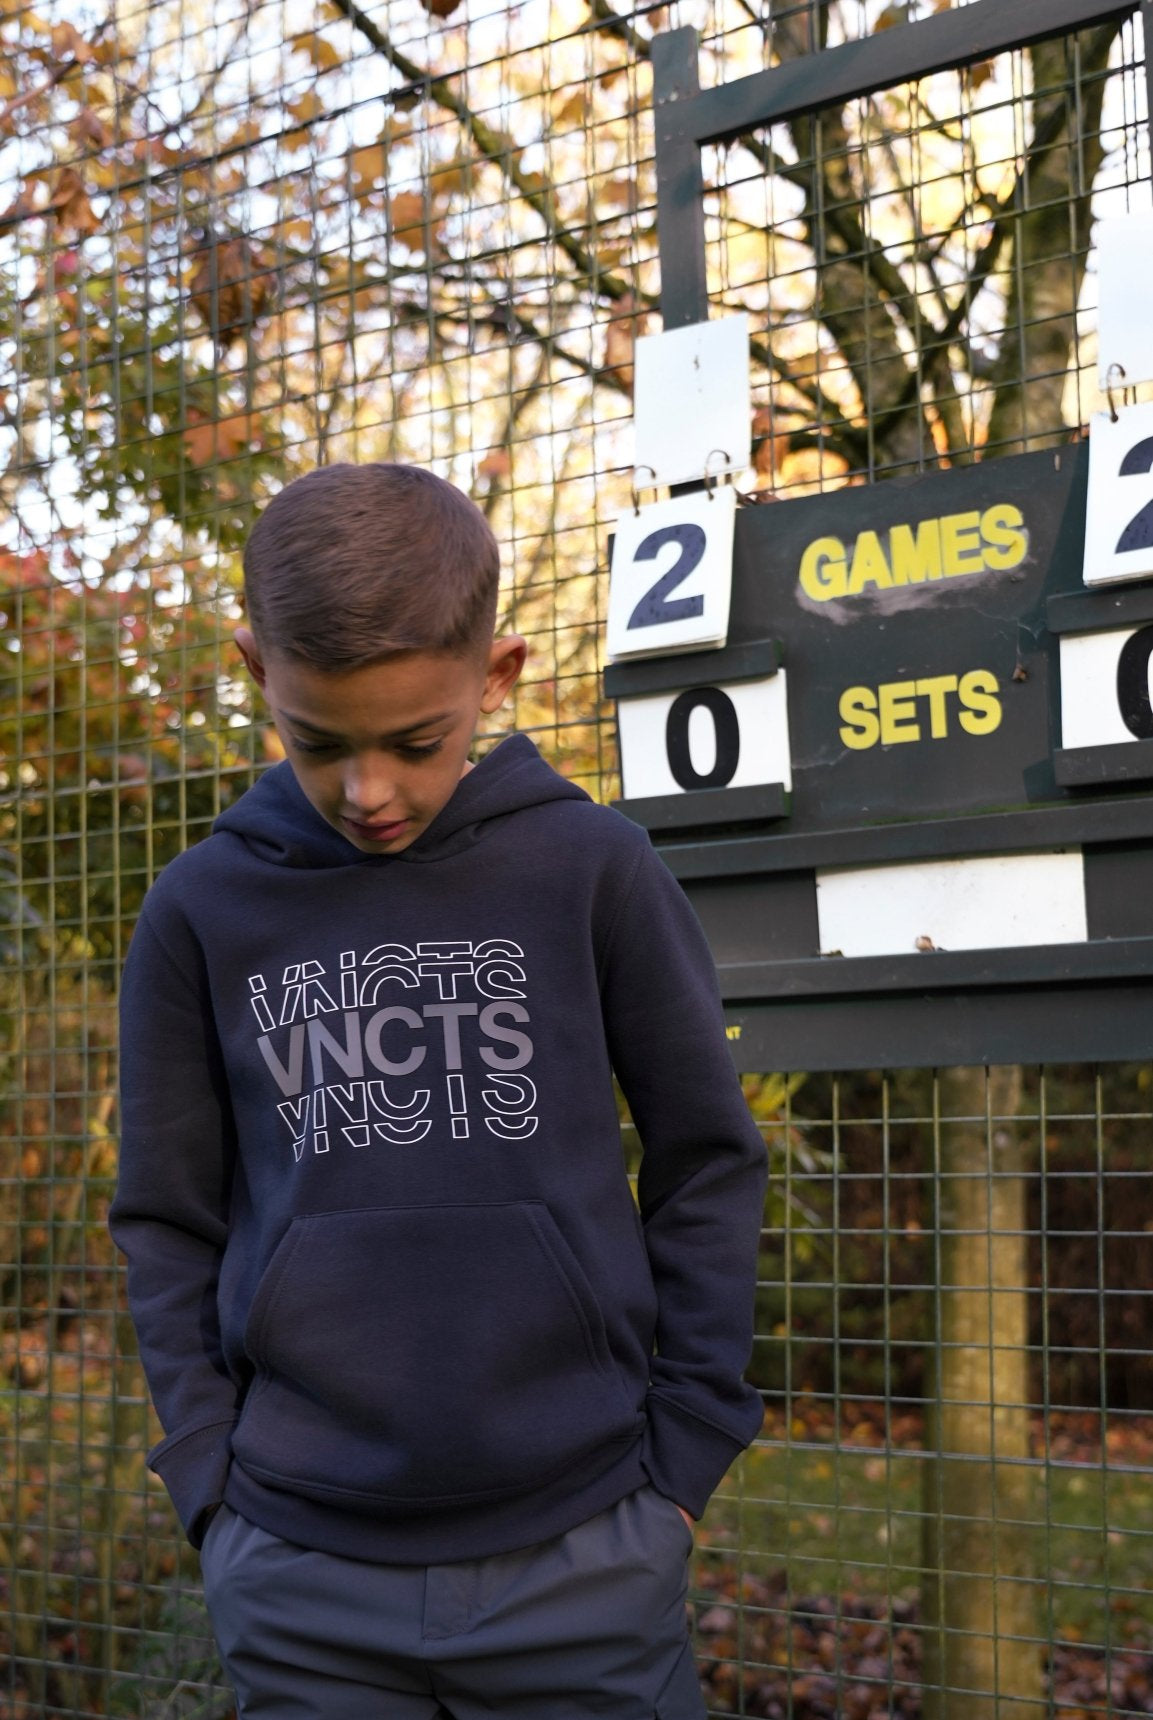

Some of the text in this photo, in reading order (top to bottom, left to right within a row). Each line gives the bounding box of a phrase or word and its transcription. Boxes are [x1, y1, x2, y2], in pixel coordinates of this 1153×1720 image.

[626, 522, 707, 632] 2
[799, 504, 1027, 602] GAMES
[665, 686, 740, 791] 0
[839, 670, 1003, 750] SETS
[256, 1000, 534, 1098] VNCTS
